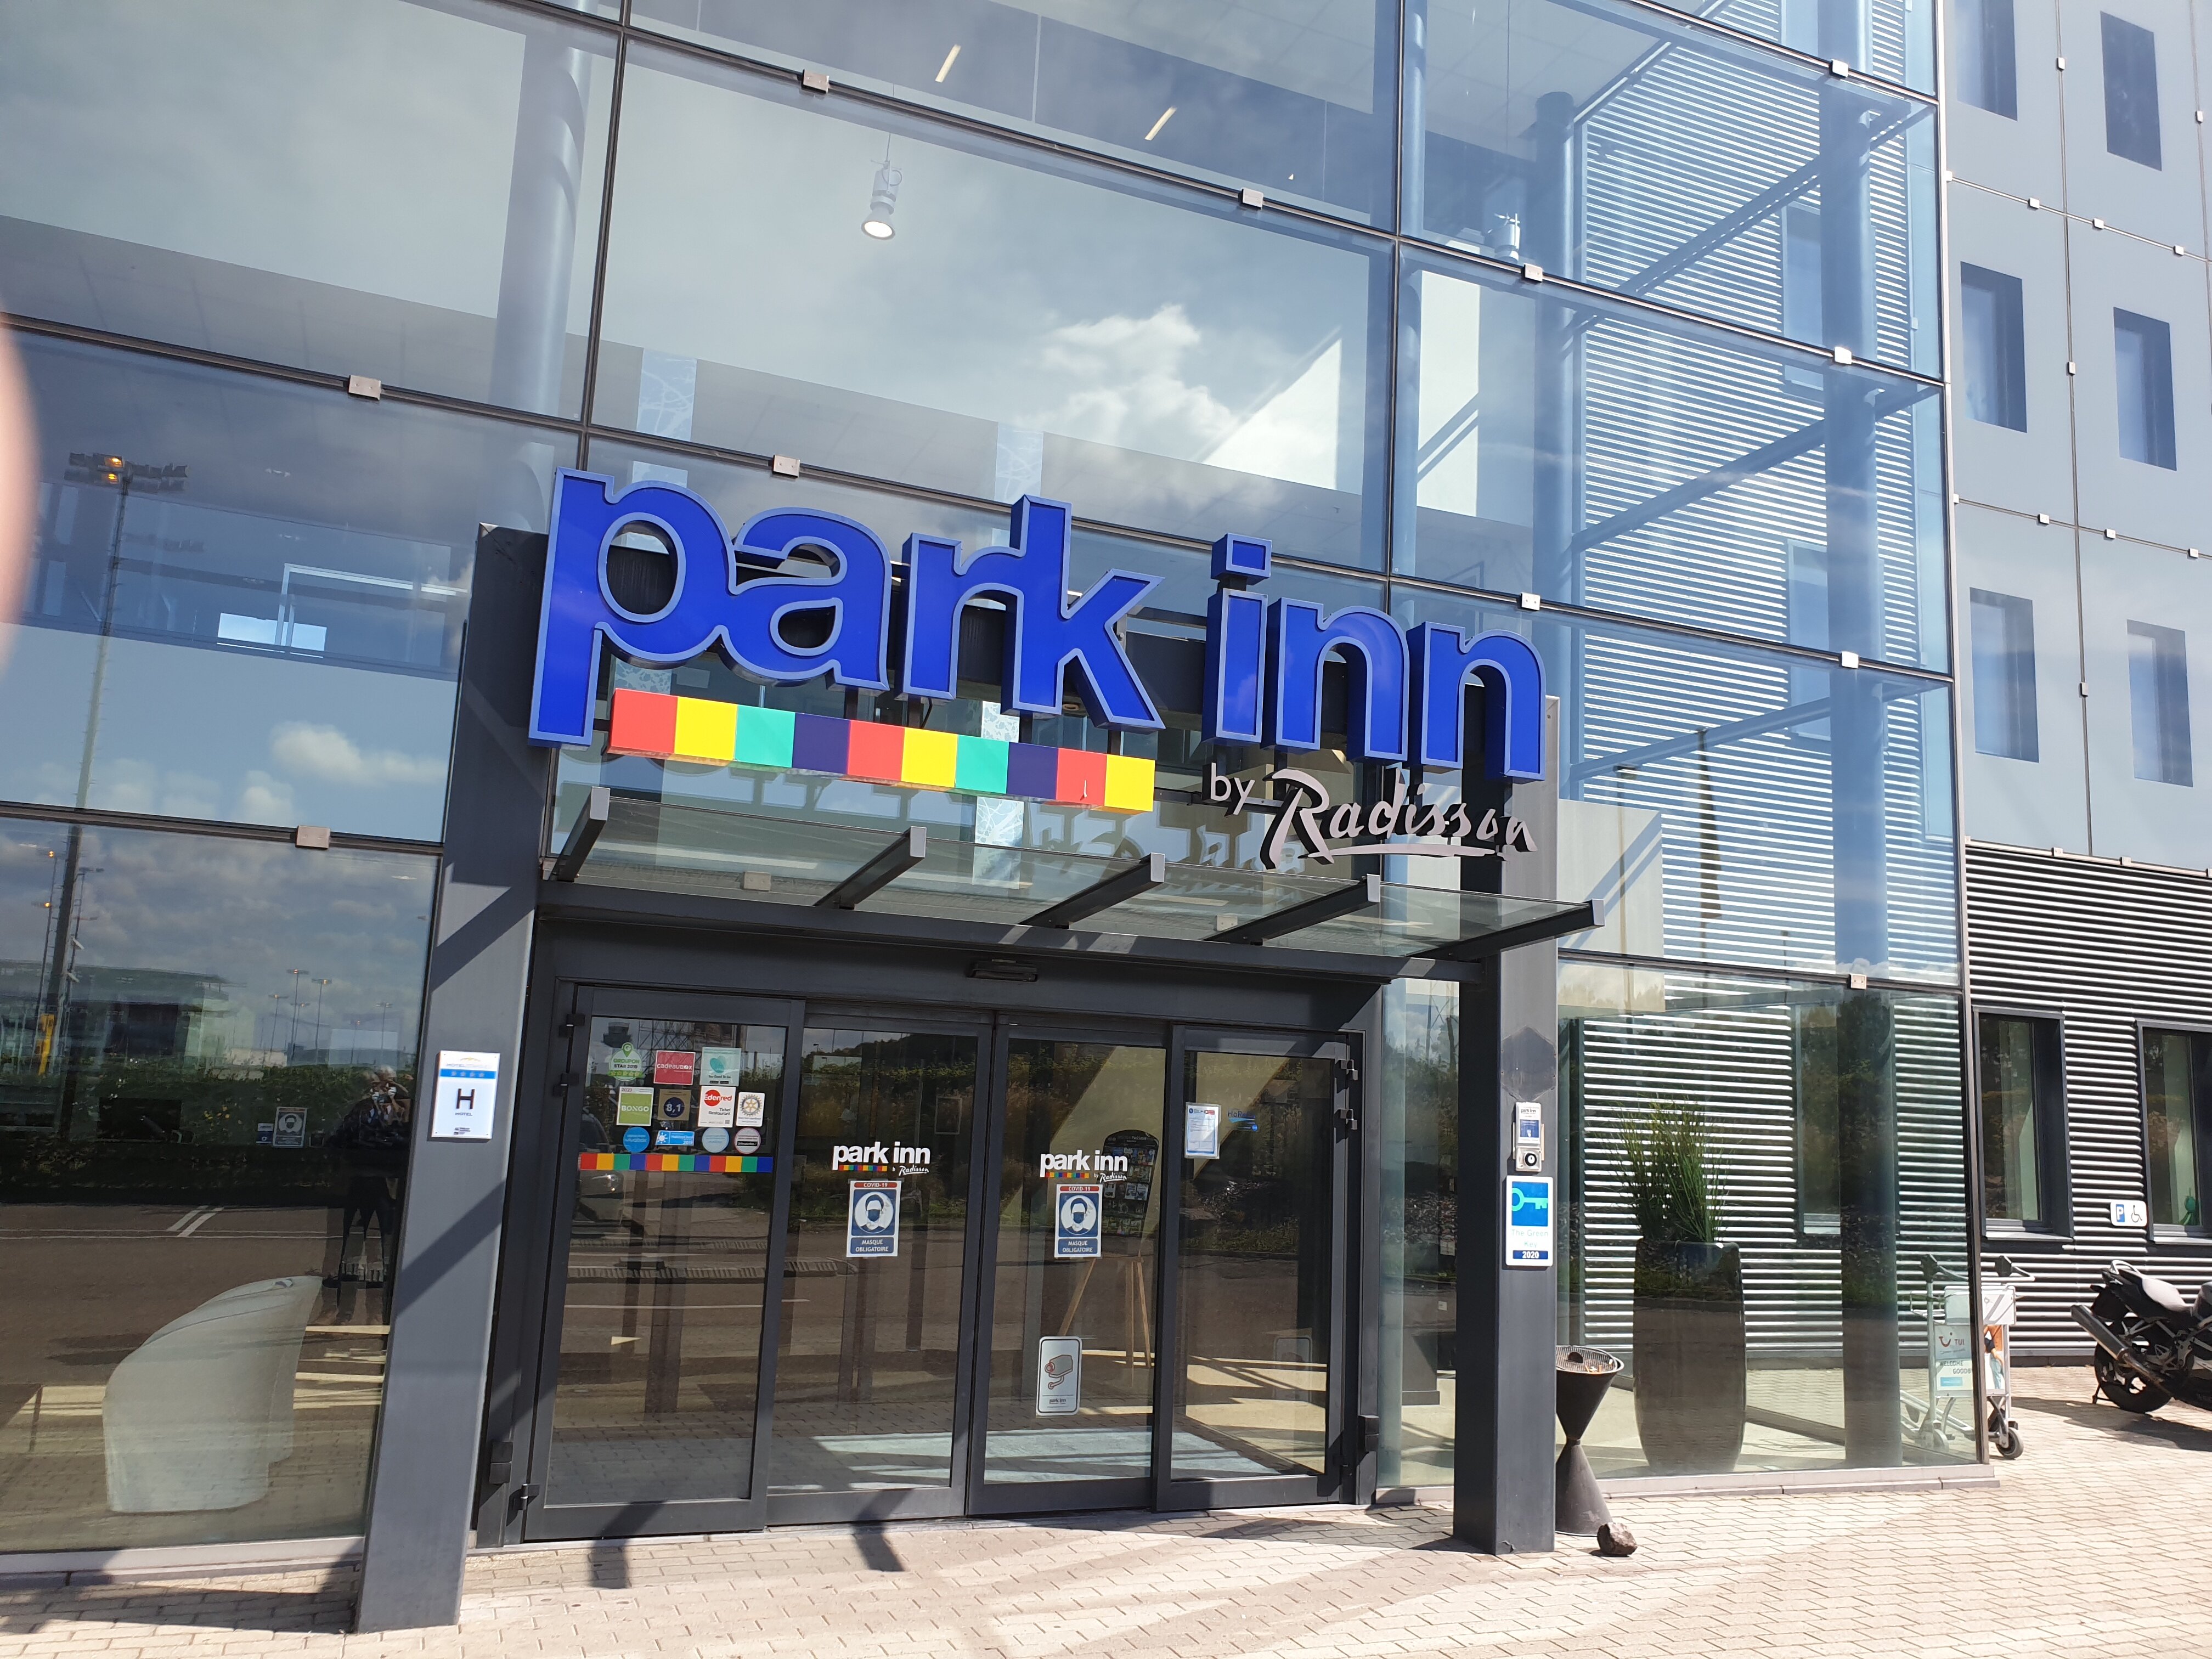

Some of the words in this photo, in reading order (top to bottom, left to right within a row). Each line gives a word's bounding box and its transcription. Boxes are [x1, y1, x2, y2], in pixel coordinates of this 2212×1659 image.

[528, 467, 1165, 748] park
[1203, 532, 1547, 782] inn
[1206, 762, 1256, 816] by
[1261, 767, 1538, 870] Radisson
[456, 1088, 476, 1110] H
[665, 1103, 681, 1113] 8,1
[832, 1141, 889, 1171] park
[893, 1141, 931, 1164] inn
[1040, 1149, 1091, 1178] park
[1094, 1150, 1128, 1172] inn
[899, 1165, 929, 1176] Radisson
[1099, 1172, 1127, 1183] Radisson
[2116, 1206, 2124, 1221] P
[1524, 1240, 1538, 1249] Key
